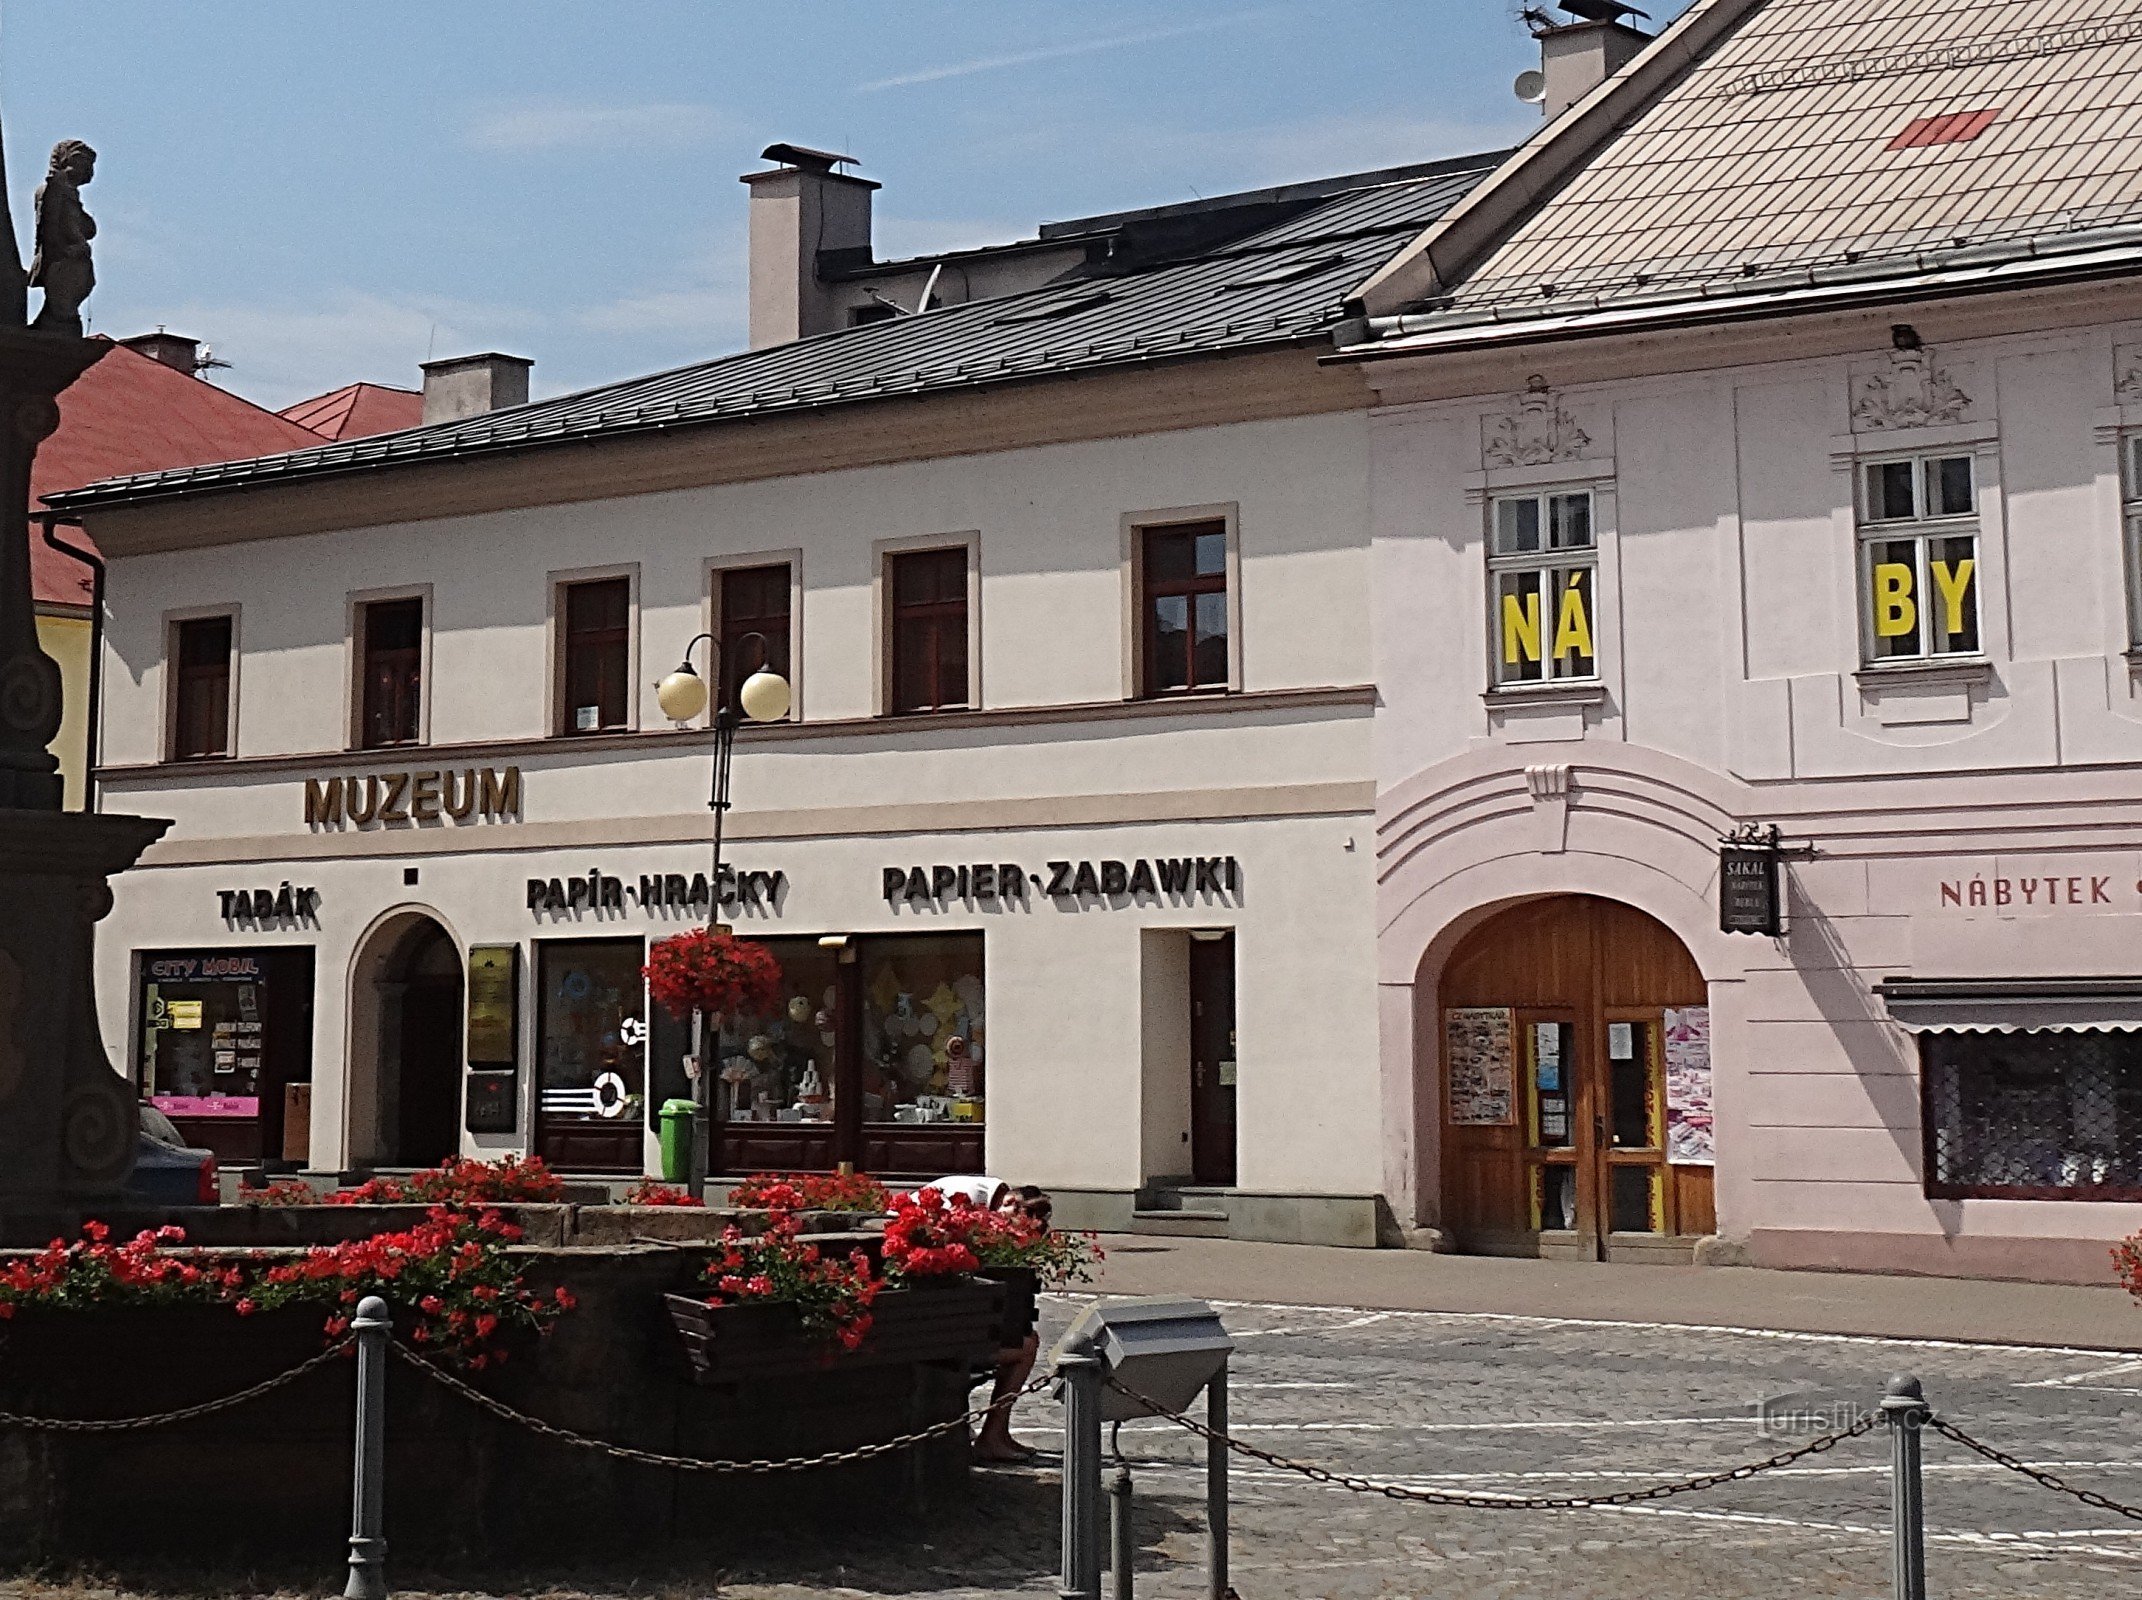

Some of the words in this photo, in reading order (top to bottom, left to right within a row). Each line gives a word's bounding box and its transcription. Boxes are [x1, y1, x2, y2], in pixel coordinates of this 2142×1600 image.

[1502, 572, 1593, 663] NÁ
[1874, 558, 1975, 638] BY
[304, 766, 519, 824] MUZEUM
[216, 880, 316, 919] TABÁK
[1940, 872, 2112, 908] NÁBYTEK
[152, 959, 198, 977] CITY
[202, 957, 260, 976] MOBIL
